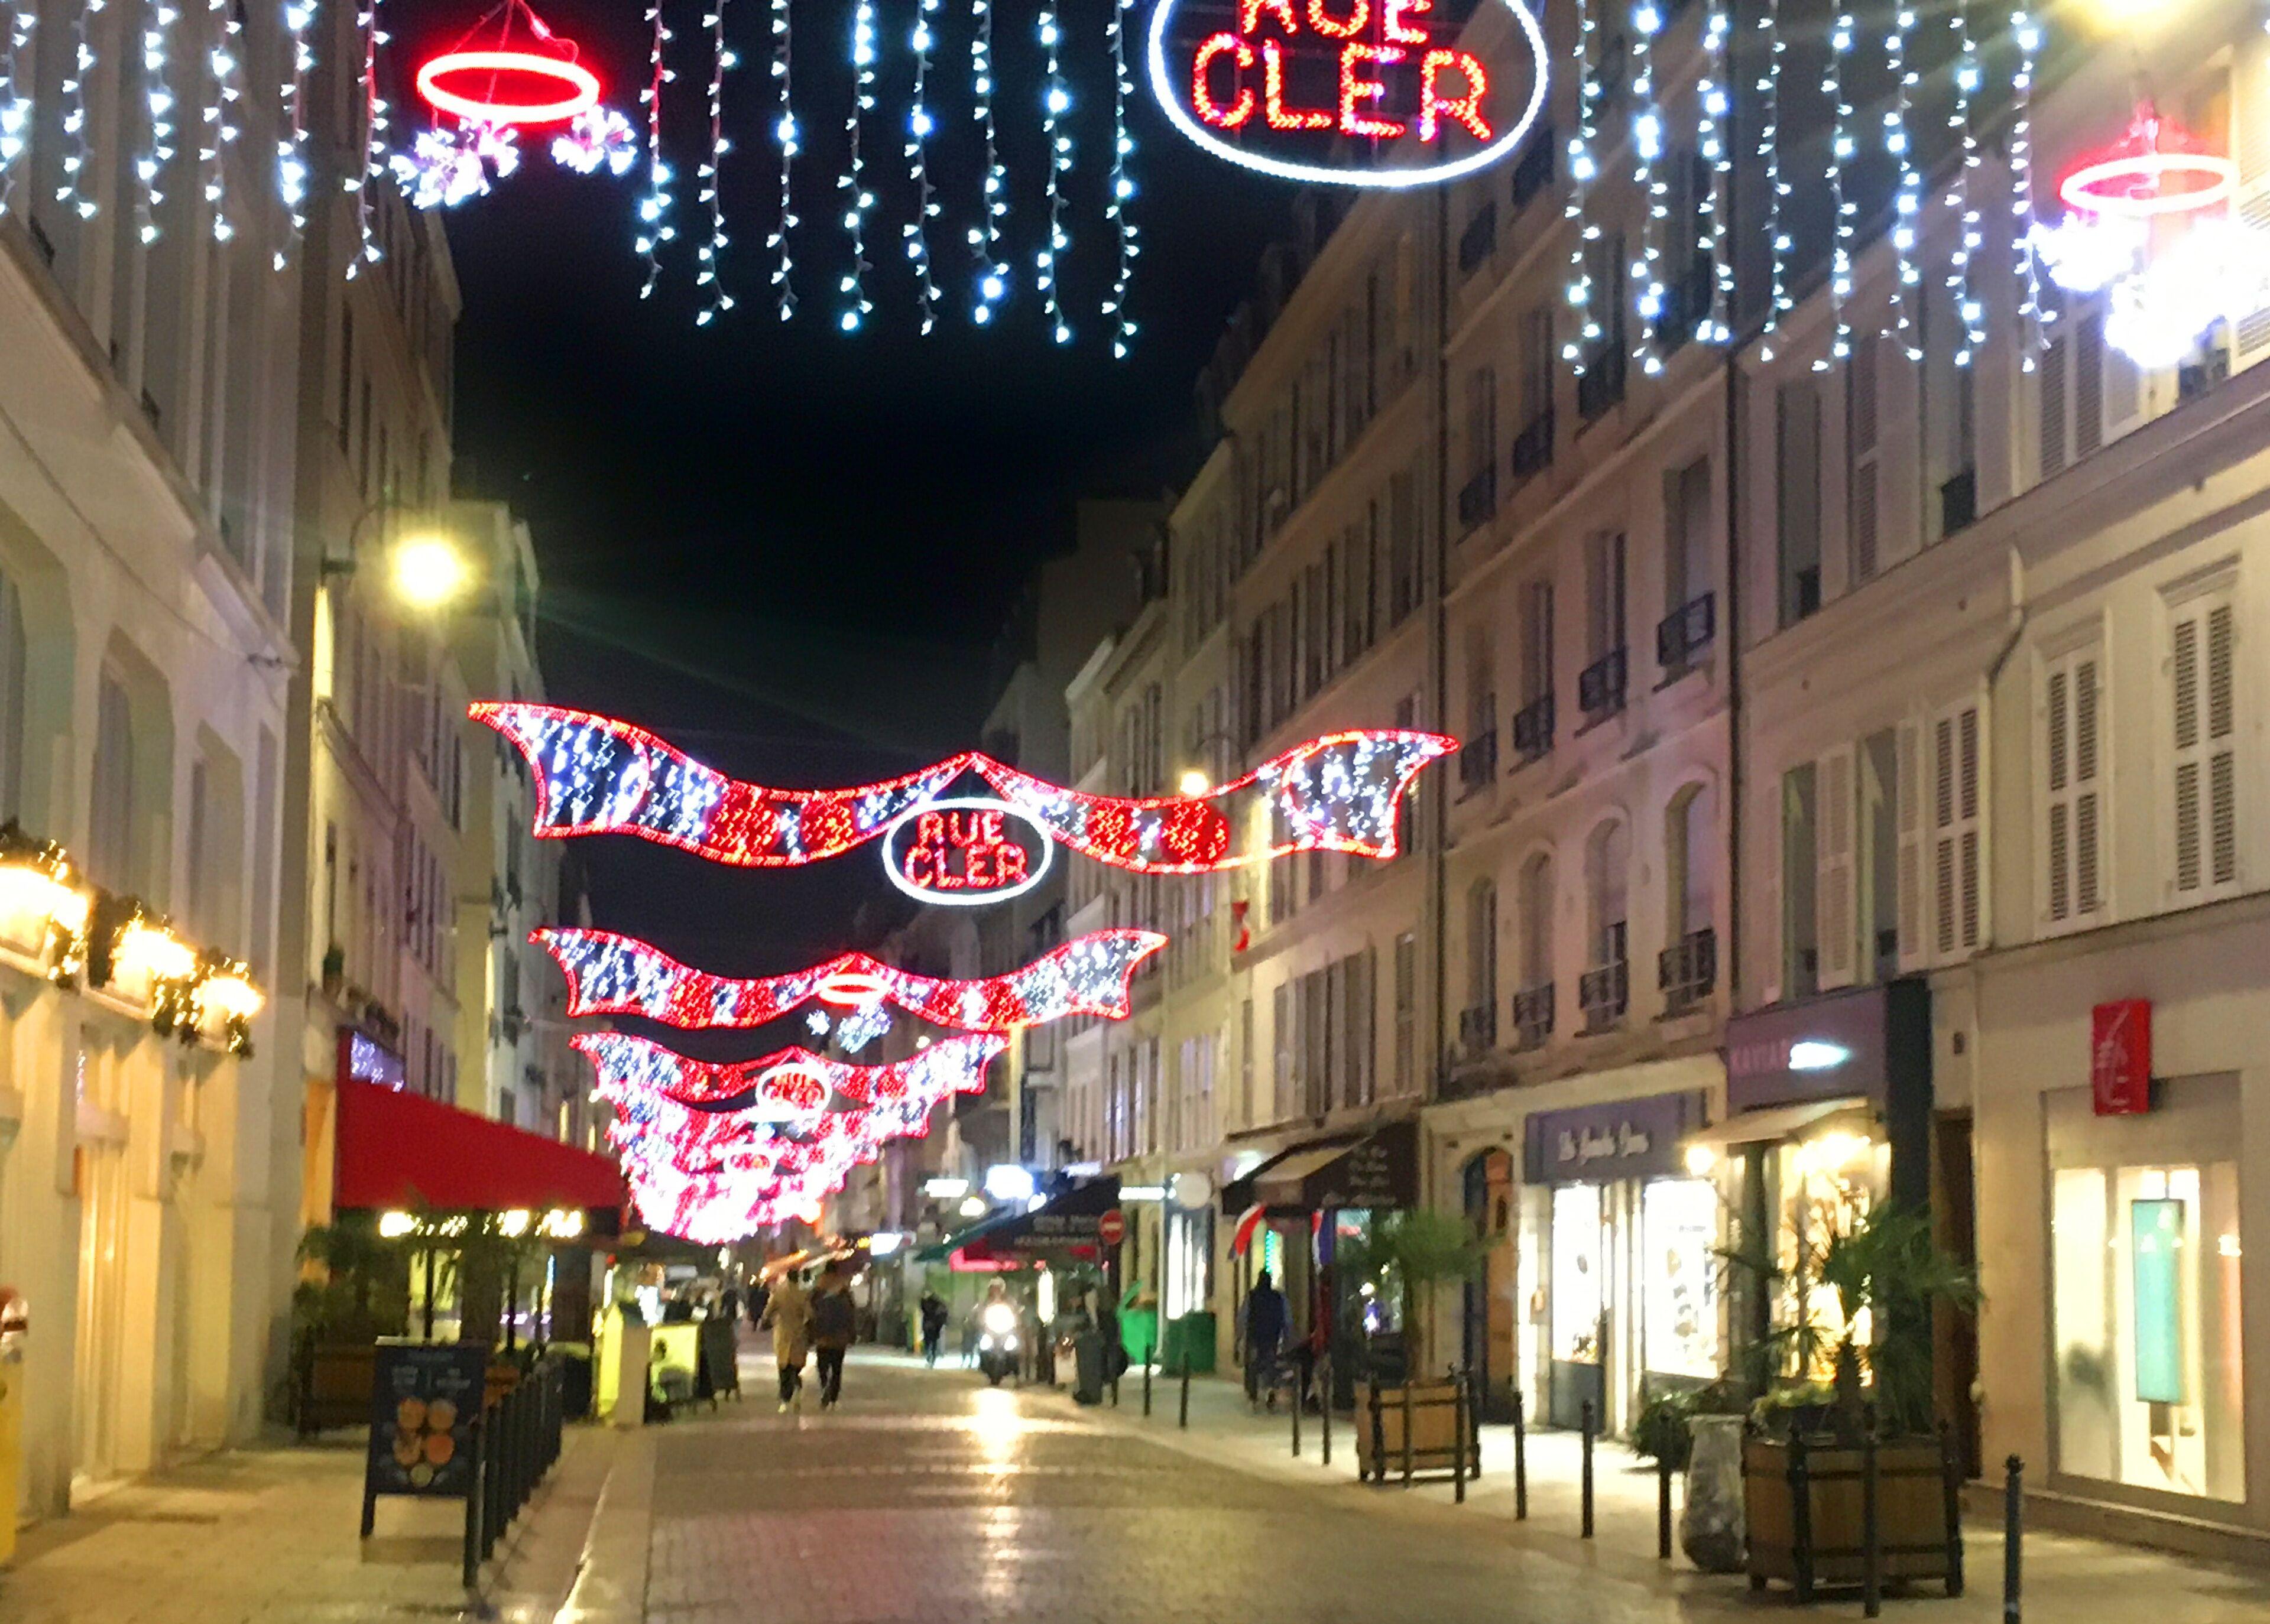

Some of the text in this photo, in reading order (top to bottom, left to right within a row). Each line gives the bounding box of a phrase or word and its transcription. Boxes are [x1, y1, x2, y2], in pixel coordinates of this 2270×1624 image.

[1192, 31, 1493, 141] CLER
[917, 810, 1004, 847] RUE
[904, 843, 1029, 889] CLER
